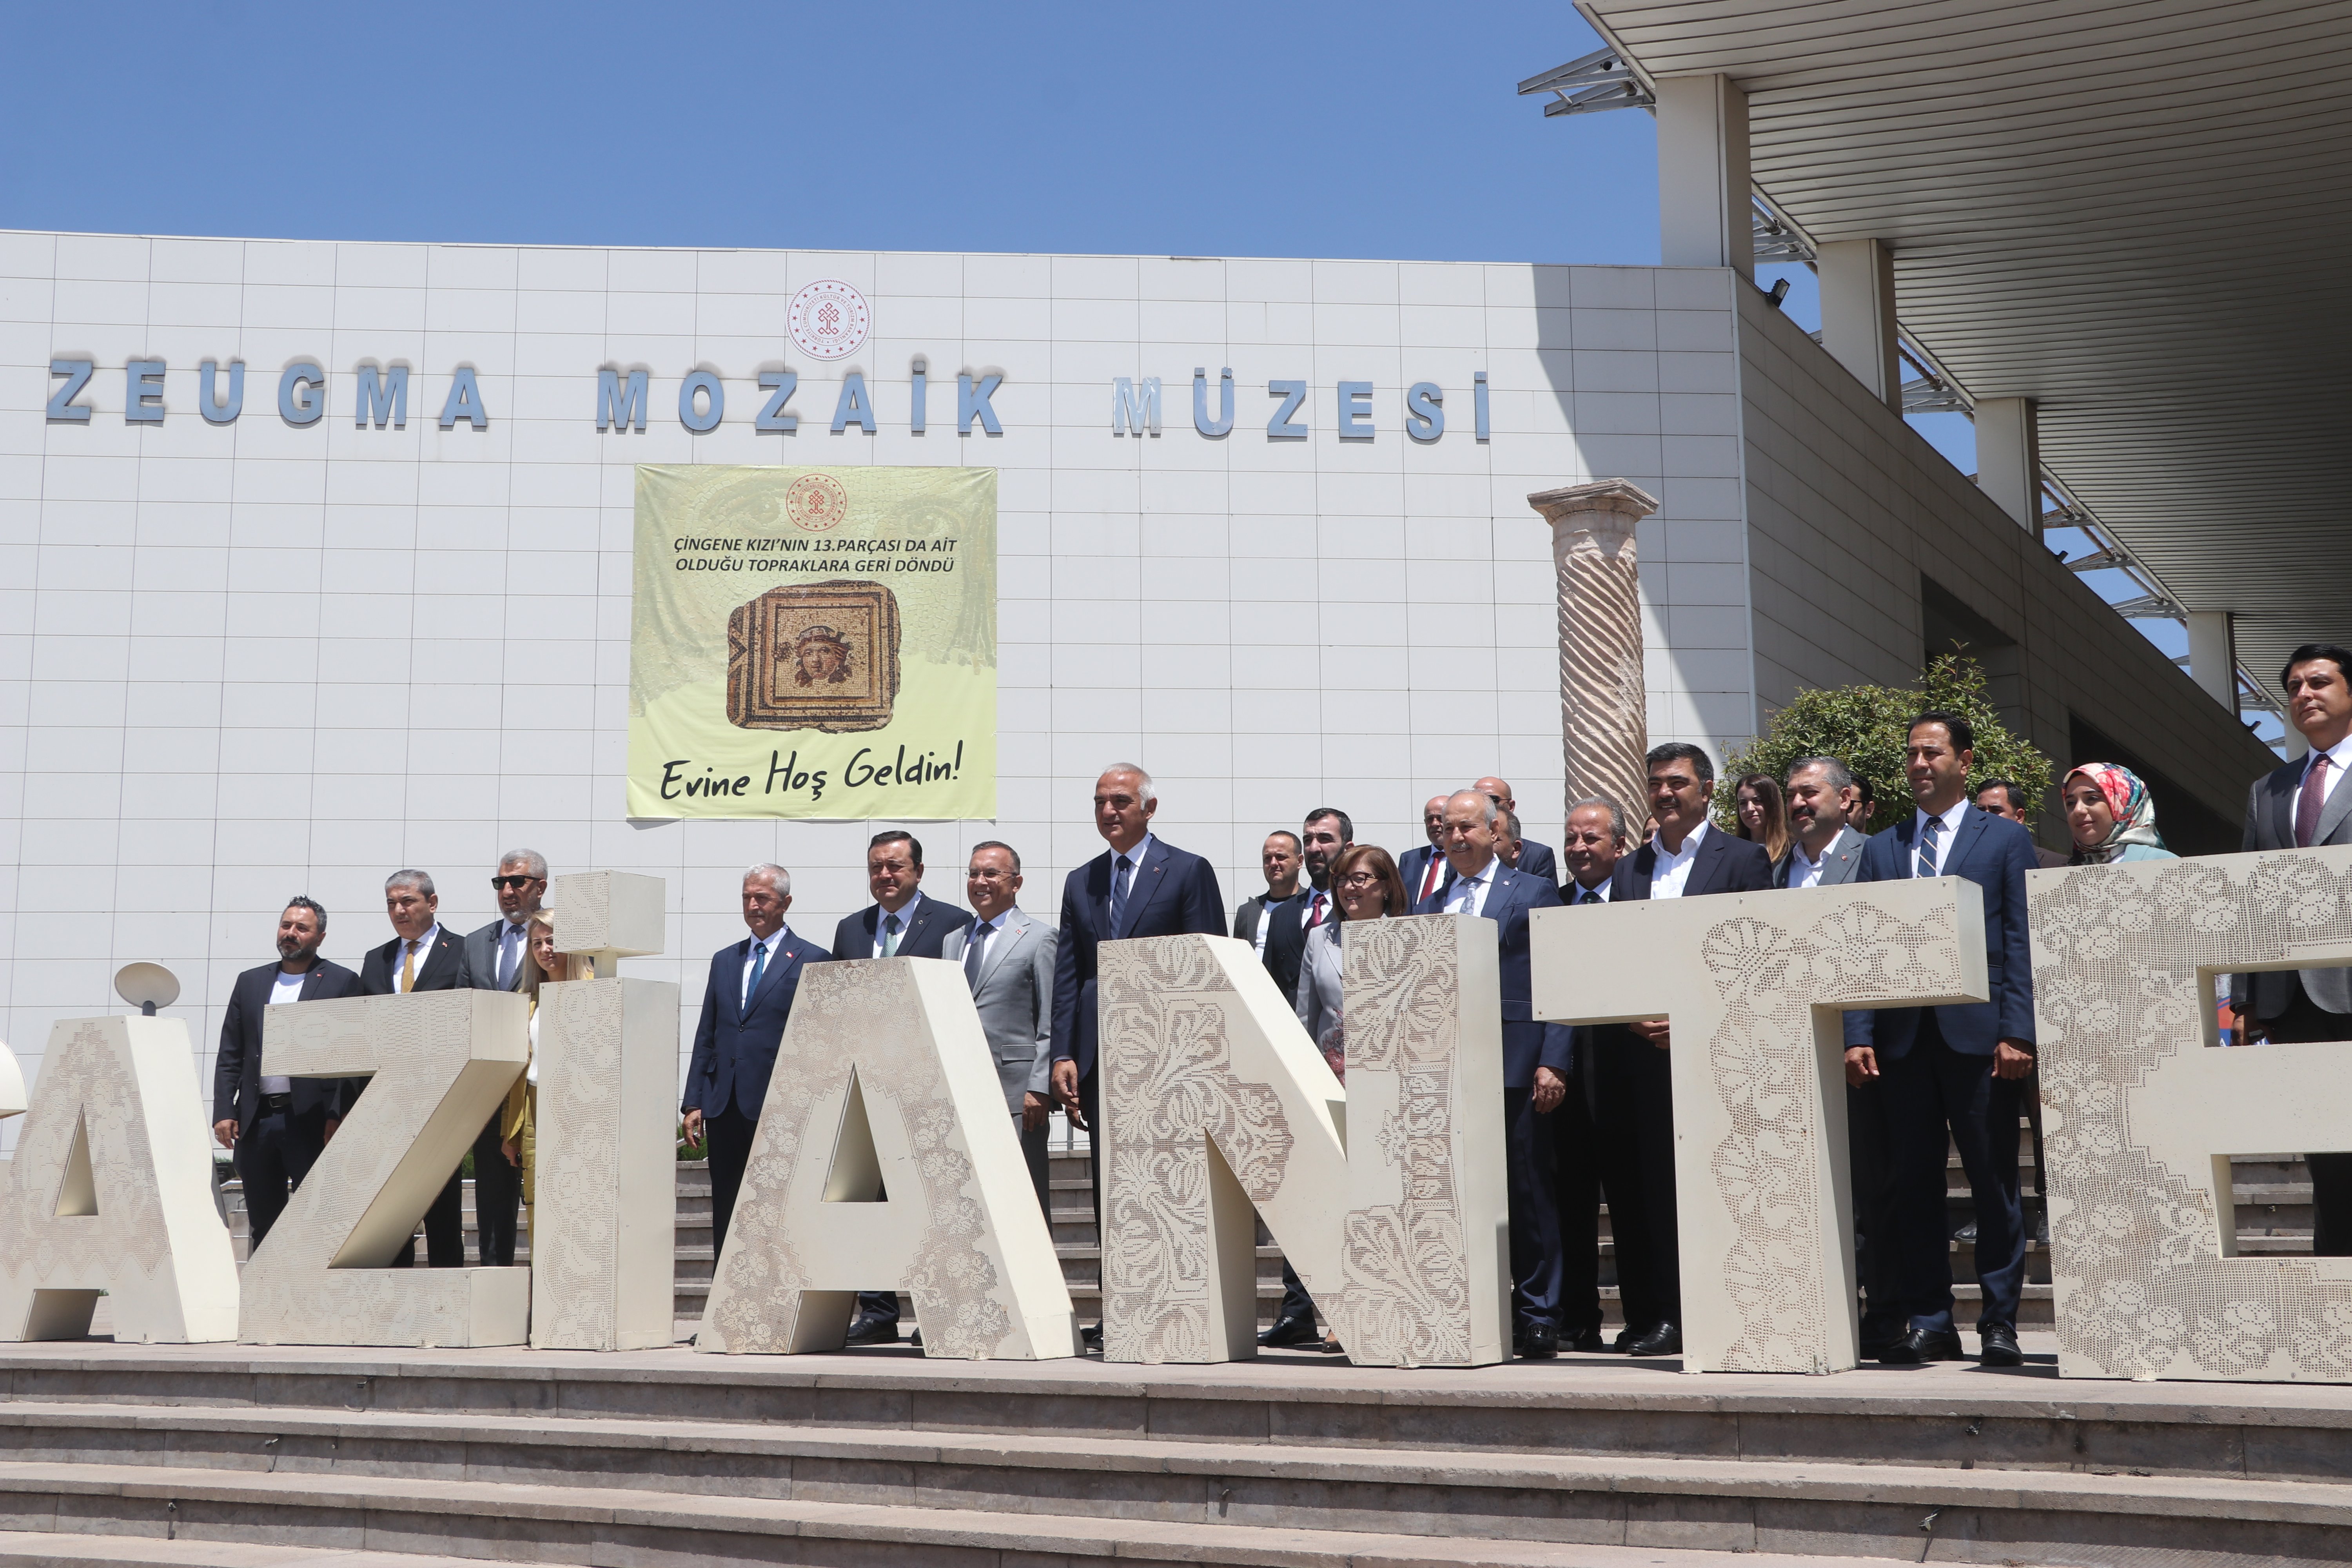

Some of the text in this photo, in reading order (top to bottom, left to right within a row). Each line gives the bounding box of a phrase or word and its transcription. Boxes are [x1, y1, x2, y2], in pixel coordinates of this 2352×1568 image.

[846, 304, 855, 322] TURİZM
[46, 361, 1489, 440] ZEUGMA MOZAİK MÜZESİ
[674, 535, 742, 553] ÇİNGENE
[813, 539, 901, 554] 13.PARÇASI
[905, 540, 926, 552] DA
[931, 537, 957, 552] AİT
[676, 555, 954, 572] OLDUĞU TOPRAKLARA GERİ DÖNDÜ
[661, 740, 963, 801] Evine Hoş Geldin!
